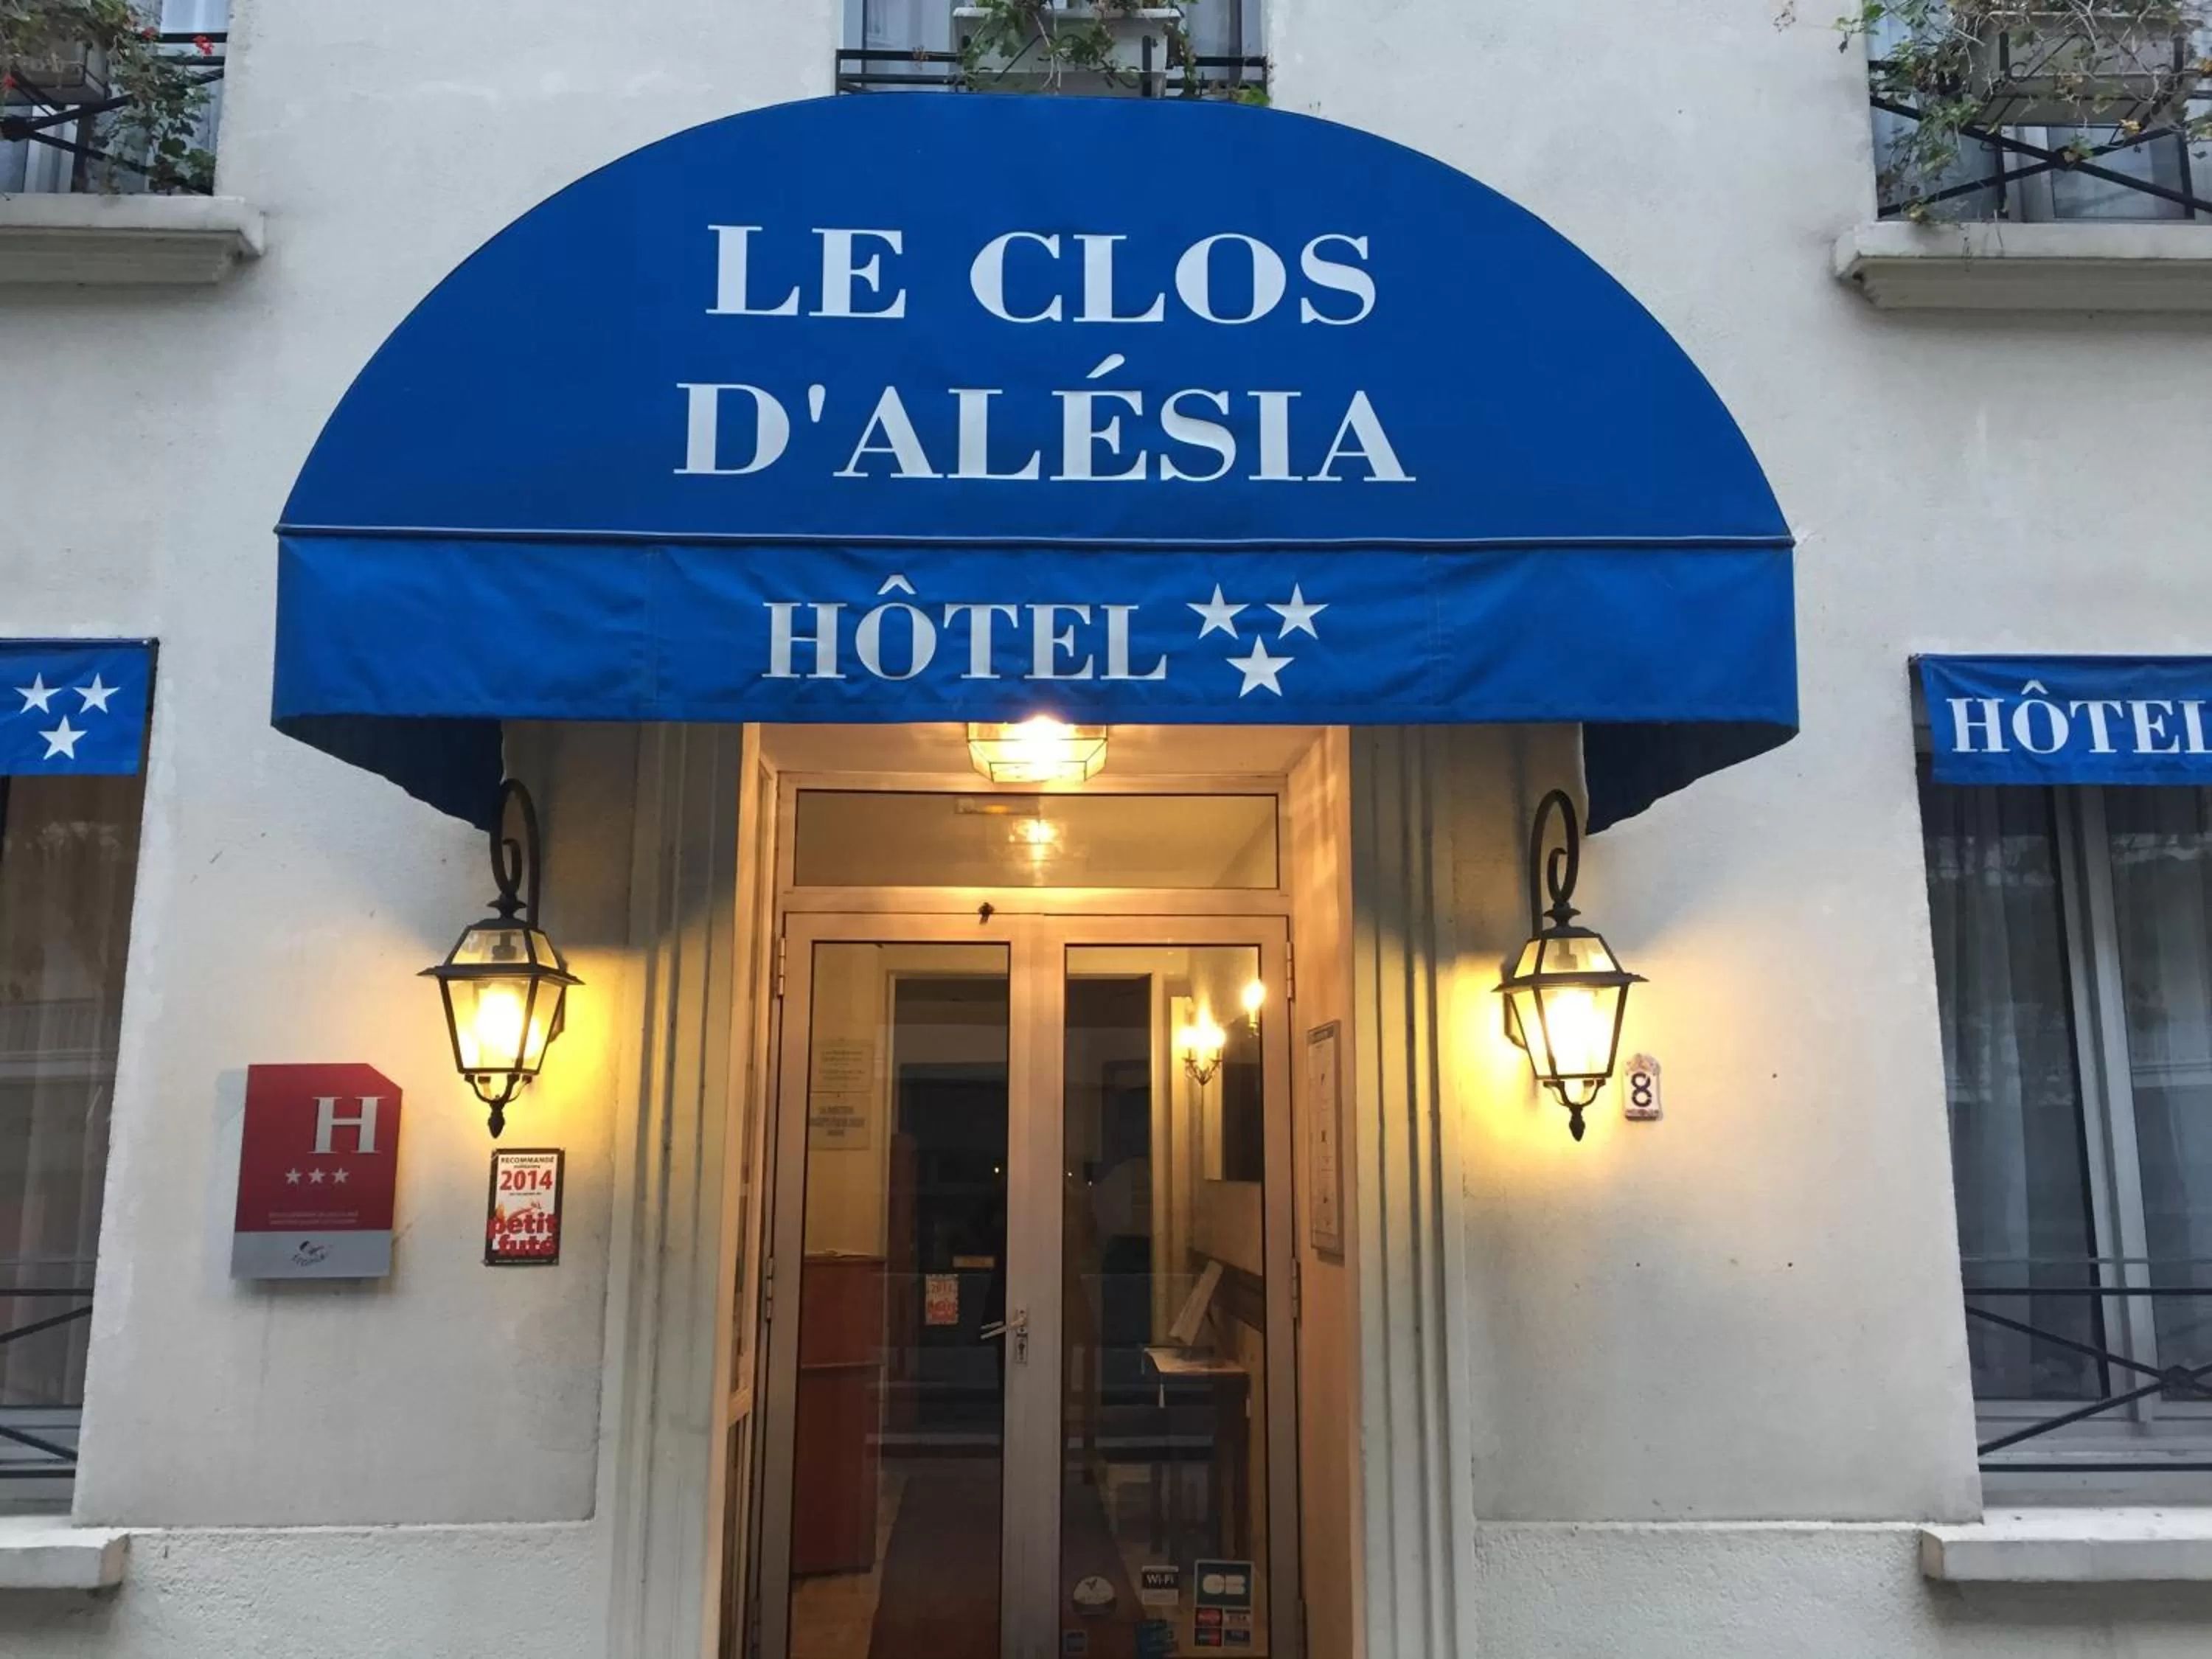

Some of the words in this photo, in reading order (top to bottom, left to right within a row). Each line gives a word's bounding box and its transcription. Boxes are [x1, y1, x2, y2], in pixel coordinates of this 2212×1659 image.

[705, 224, 907, 318] LE
[970, 232, 1377, 325] CLOS
[673, 353, 1417, 482] D'ALÉSIA
[761, 574, 1167, 681] HÔTEL
[1631, 1072, 1652, 1107] 8
[307, 1096, 389, 1154] H
[499, 1169, 553, 1191] 2014
[487, 1211, 557, 1239] petit
